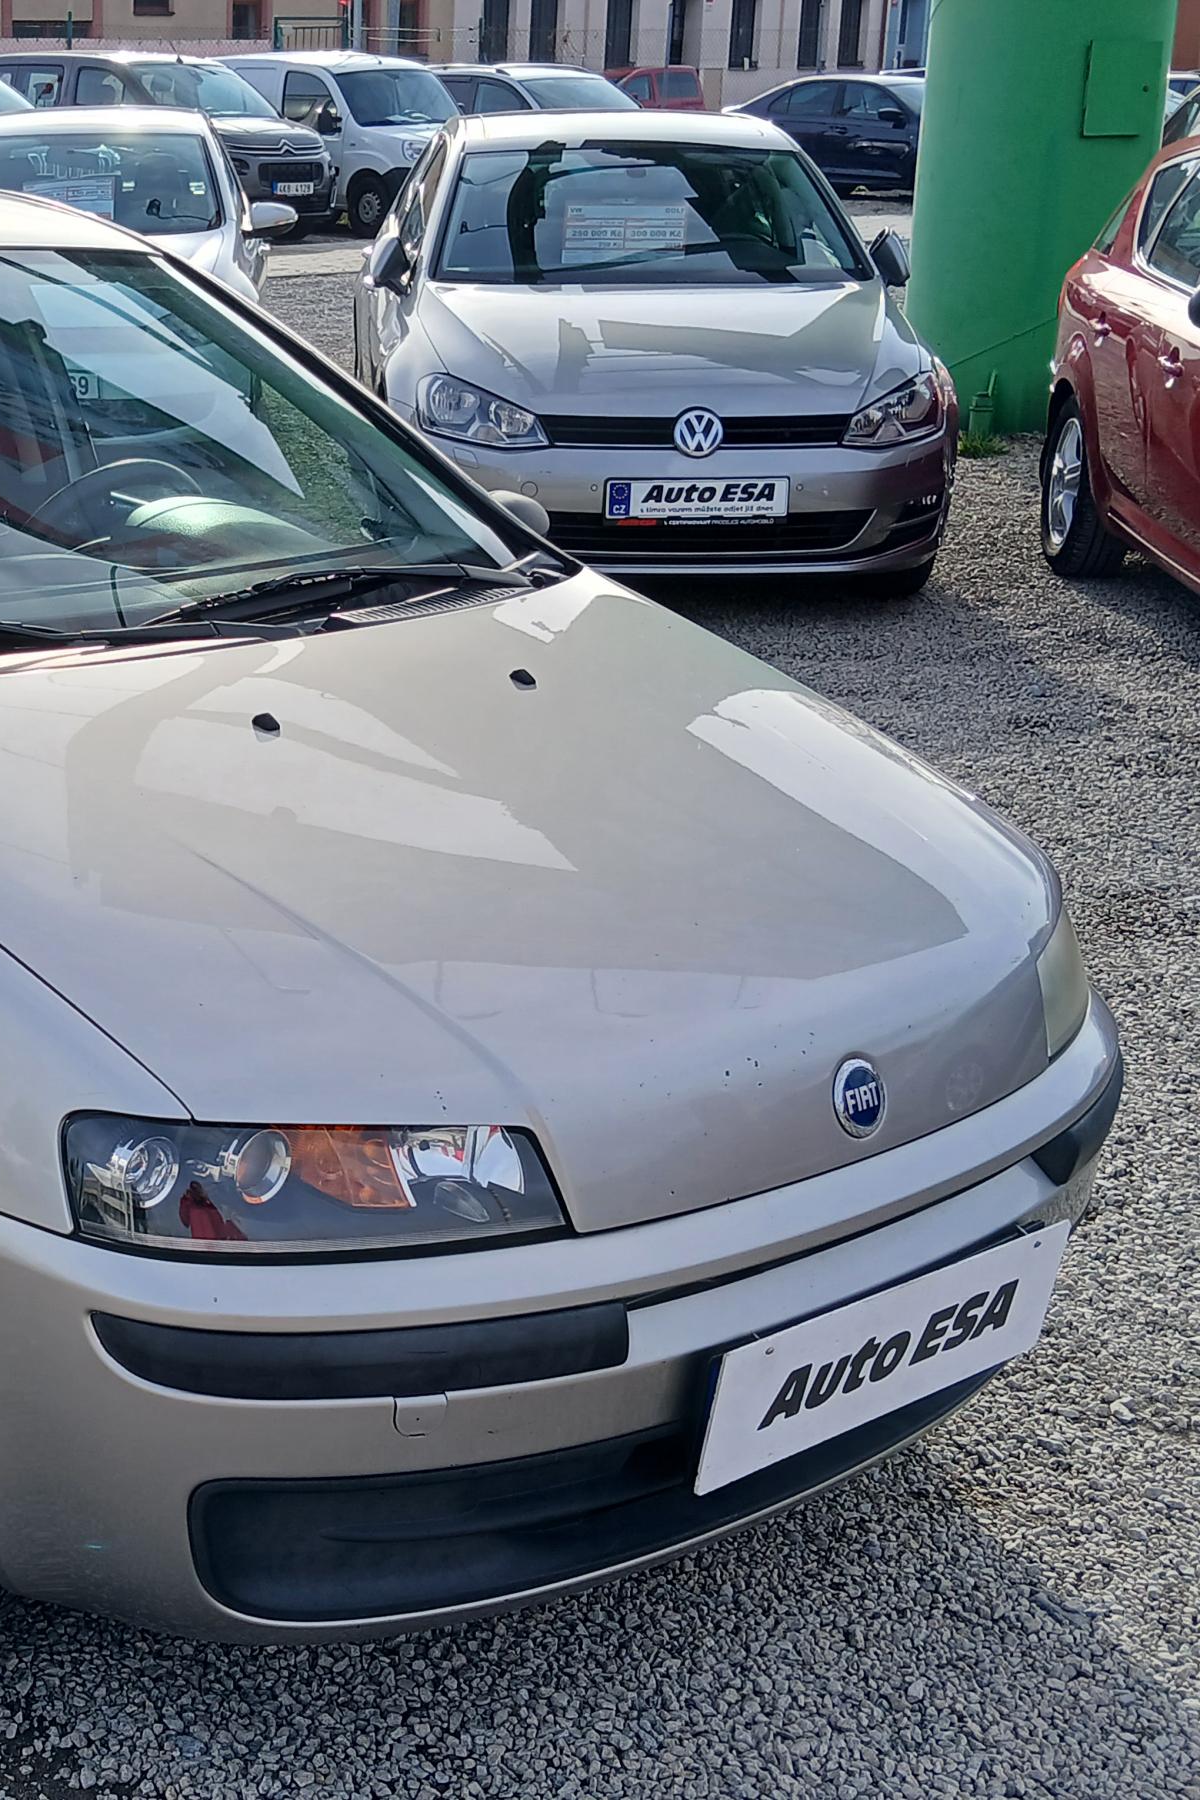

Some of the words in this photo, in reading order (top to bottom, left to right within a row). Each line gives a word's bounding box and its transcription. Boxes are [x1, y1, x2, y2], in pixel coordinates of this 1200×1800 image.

[641, 484, 717, 504] Auto
[719, 483, 776, 502] ESA
[612, 505, 626, 514] CZ
[845, 1081, 879, 1115] FIAT
[757, 1331, 912, 1431] Auto
[908, 1278, 1020, 1367] ESA
